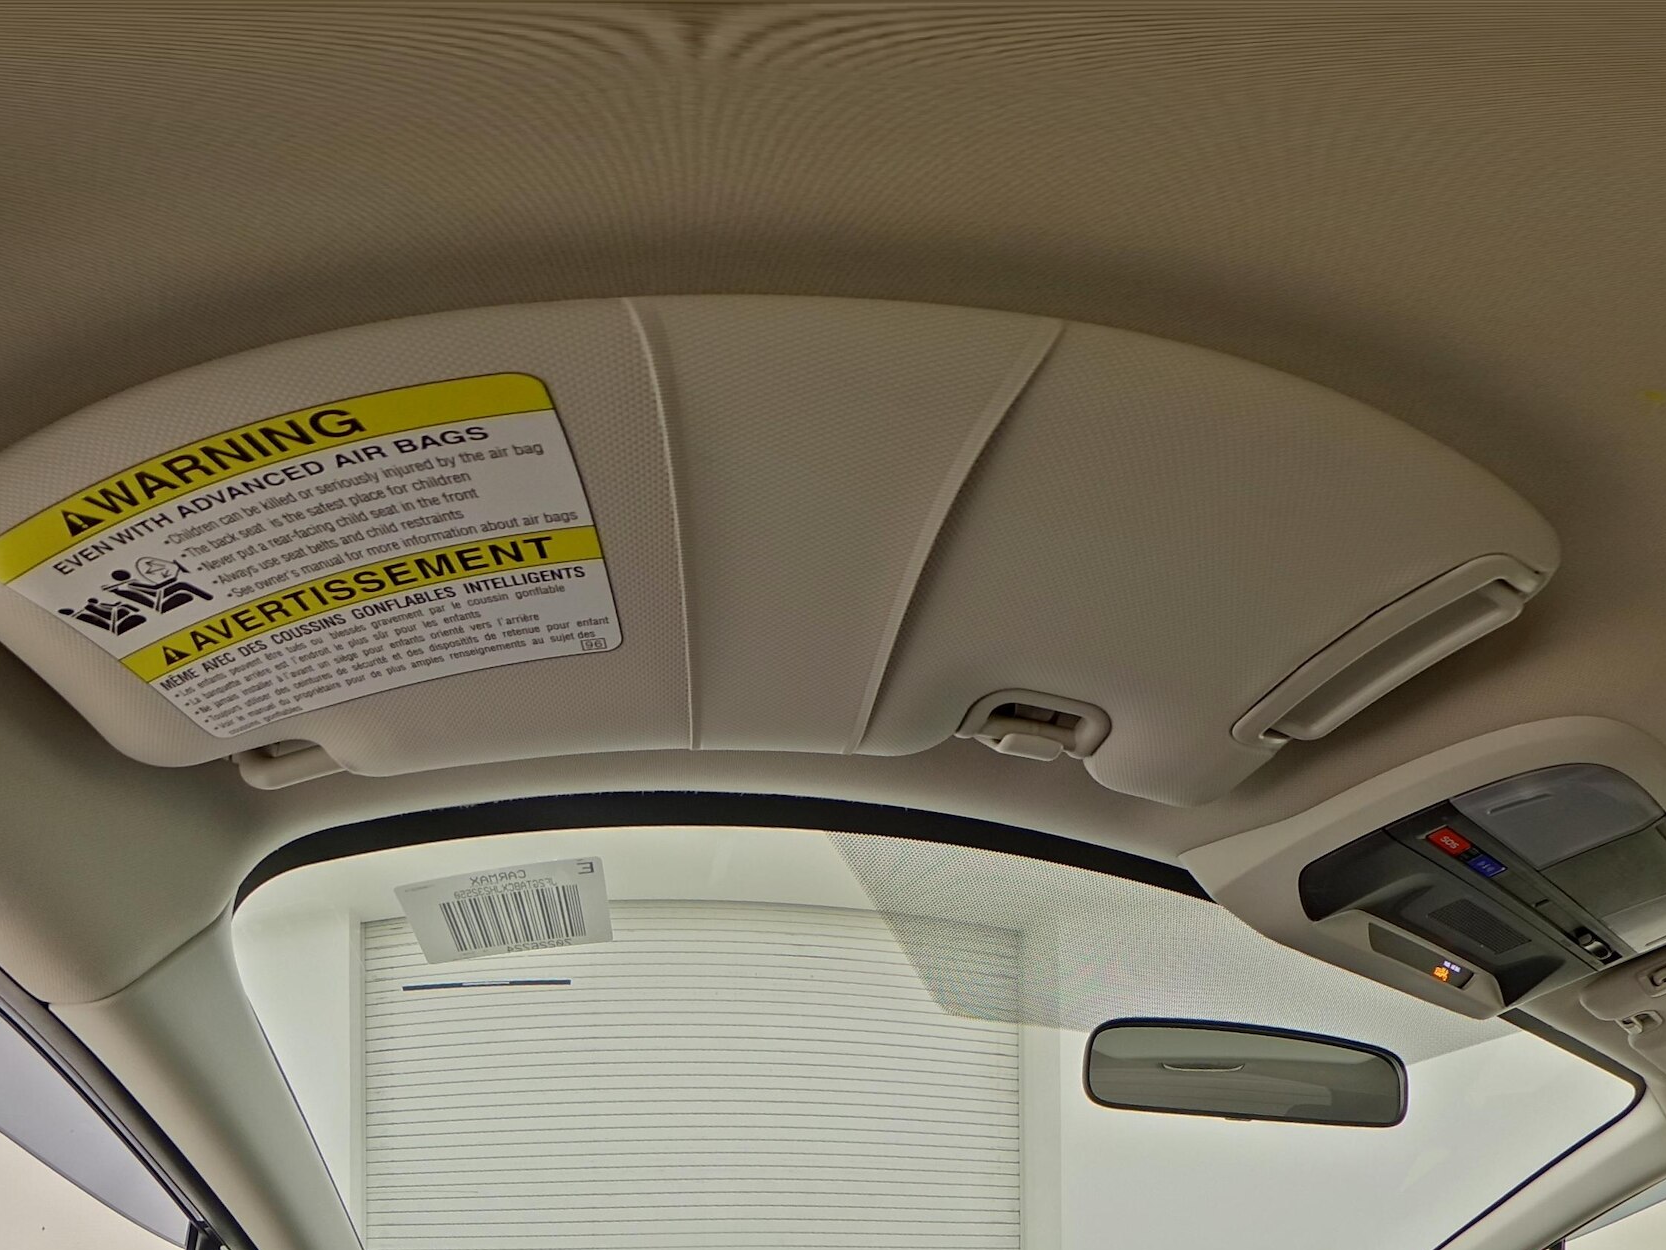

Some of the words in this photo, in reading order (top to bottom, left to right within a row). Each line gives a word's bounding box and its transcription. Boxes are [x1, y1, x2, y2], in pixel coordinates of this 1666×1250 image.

[53, 541, 113, 576] EVEN
[109, 513, 173, 544] WITH
[177, 460, 325, 518] ADVANCED
[335, 445, 388, 468] AIR
[393, 426, 489, 454] BAGS
[83, 409, 366, 515] WARNING
[168, 521, 219, 544] Children
[220, 512, 241, 527] can
[244, 503, 260, 518] be
[262, 491, 297, 513] killed
[298, 488, 314, 500] or
[315, 471, 379, 496] seriously
[382, 460, 434, 482] injured
[436, 455, 455, 470] by
[459, 448, 484, 463] the
[489, 446, 508, 459] air
[513, 442, 544, 456] bag
[185, 543, 209, 560] The
[211, 532, 238, 552] back
[240, 523, 267, 541] seat
[270, 518, 281, 532] is
[283, 510, 304, 525] the
[306, 499, 348, 518] safest
[351, 489, 385, 507] place
[386, 484, 409, 498] for
[412, 471, 471, 490] children
[201, 556, 234, 572] Never
[236, 547, 258, 563] put
[259, 541, 267, 552] a
[270, 520, 335, 549] rear-facing
[336, 509, 370, 527] child
[371, 502, 399, 517] seat
[401, 499, 414, 512] in
[416, 494, 440, 508] the
[442, 487, 480, 504] front
[217, 562, 259, 586] Always
[262, 554, 281, 568] use
[283, 547, 308, 562] seat
[310, 538, 338, 555] belts
[339, 531, 363, 546] and
[366, 521, 398, 539] child
[400, 509, 465, 532] restraints
[232, 583, 252, 598] See
[254, 565, 300, 592] owner's
[300, 553, 344, 575] manual
[346, 547, 363, 561] for
[366, 541, 400, 558] more
[402, 523, 481, 547] information
[482, 517, 519, 533] about
[523, 514, 542, 527] air
[545, 509, 579, 523] bags
[160, 667, 200, 691] MÊME
[201, 652, 236, 673] AVEC
[237, 640, 268, 657] DES
[270, 613, 347, 645] COUSSINS
[351, 586, 457, 620] GONFLABLES
[463, 566, 586, 594] INTELLIGENTS
[190, 536, 552, 651] AVERTISSEMENT
[229, 657, 263, 676] peuvent
[264, 648, 283, 660] être
[286, 641, 307, 654] tués
[310, 636, 324, 646] ou
[329, 623, 367, 640] blessés
[370, 609, 424, 630] gravement
[429, 604, 446, 616] par
[451, 600, 461, 610] le
[467, 593, 509, 608] coussin
[515, 583, 565, 601] gonflable
[274, 661, 289, 671] est
[334, 642, 345, 651] le
[347, 635, 369, 649] plus
[373, 629, 389, 641] sûr
[395, 624, 417, 637] pour
[423, 618, 438, 629] les
[443, 609, 482, 625] enfants
[318, 659, 330, 669] un
[334, 649, 358, 666] siège
[362, 644, 385, 658] pour
[389, 633, 426, 649] enfants
[430, 624, 465, 640] orienté
[470, 621, 492, 632] vers
[335, 665, 348, 676] de
[351, 654, 389, 672] sécurité
[392, 651, 403, 661] et
[406, 646, 425, 658] des
[429, 634, 480, 653] dispositifs
[484, 630, 497, 641] de
[502, 624, 541, 639] retenue
[546, 620, 571, 633] pour
[576, 615, 610, 628] enfant
[344, 674, 366, 688] pour
[369, 669, 382, 679] de
[385, 662, 407, 676] plus
[410, 655, 445, 670] amples
[449, 640, 527, 660] renseignements
[531, 636, 544, 646] au
[549, 631, 575, 645] sujet
[577, 629, 596, 640] des
[1440, 835, 1460, 850] SOS
